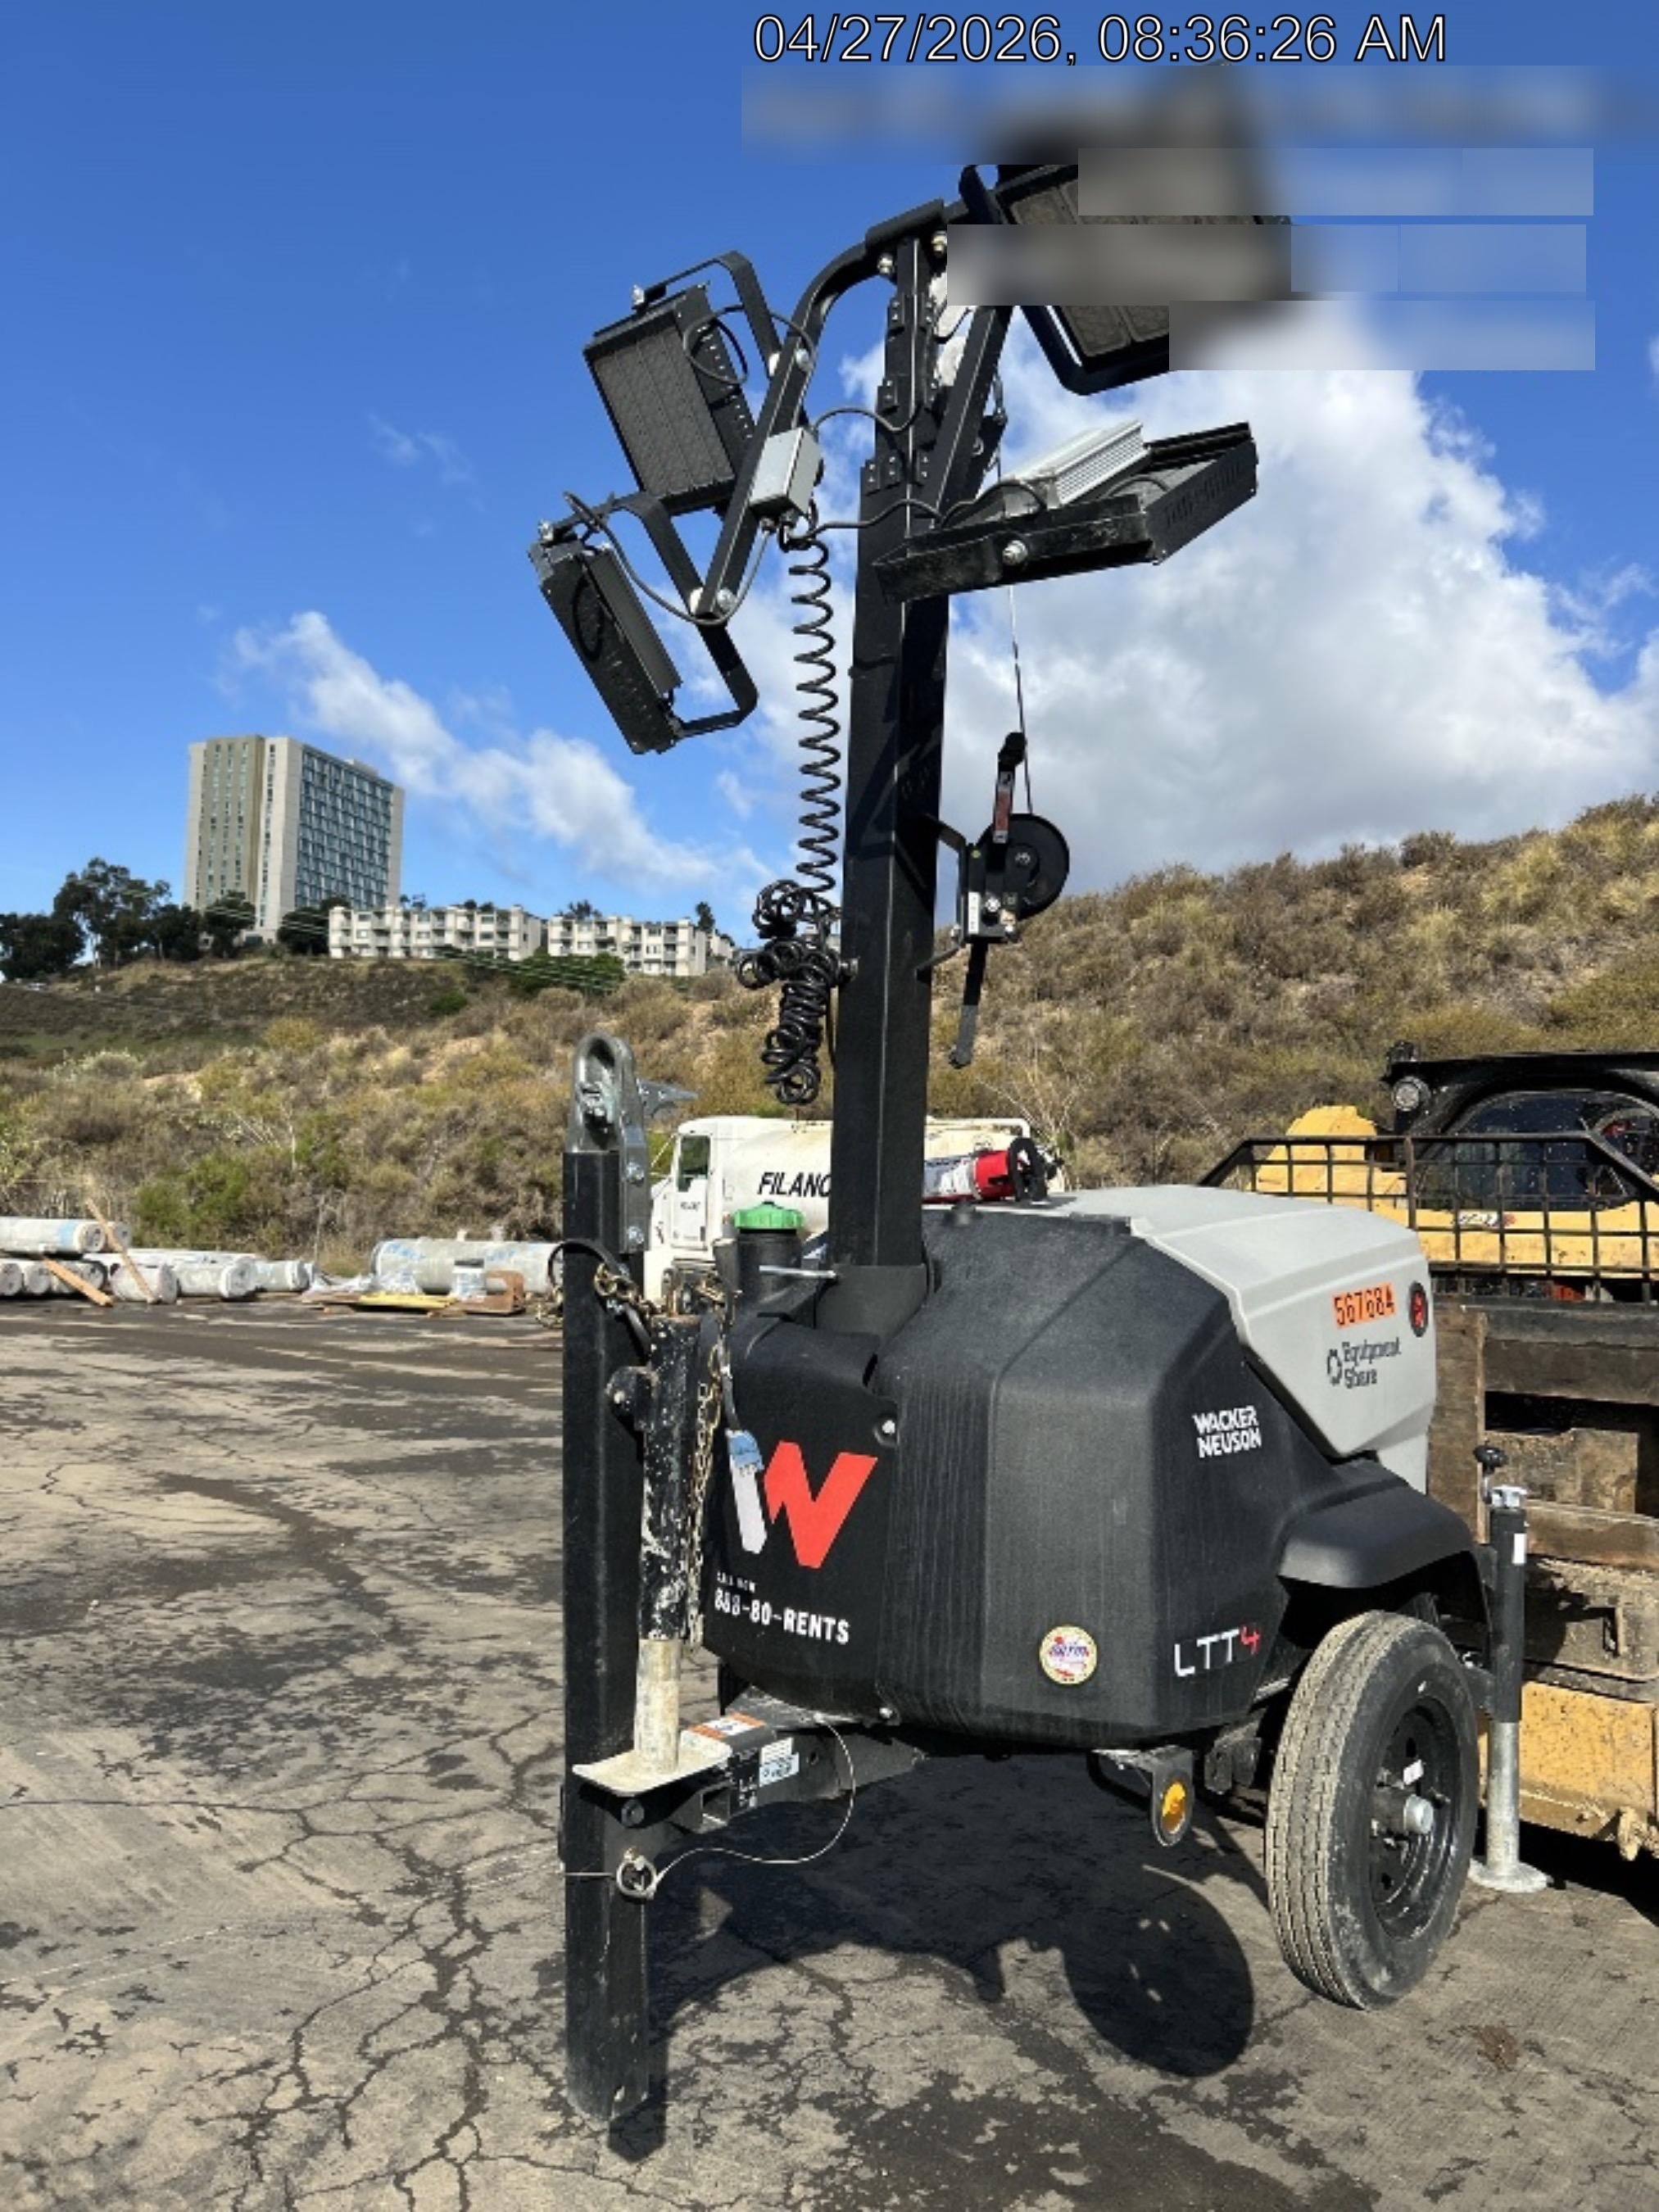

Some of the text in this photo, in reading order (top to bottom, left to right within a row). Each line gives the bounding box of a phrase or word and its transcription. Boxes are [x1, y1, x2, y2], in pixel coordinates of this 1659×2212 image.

[1192, 1404, 1258, 1435] WACKER
[1197, 1427, 1262, 1458] NEUSON
[1174, 1625, 1260, 1677] LTT4
